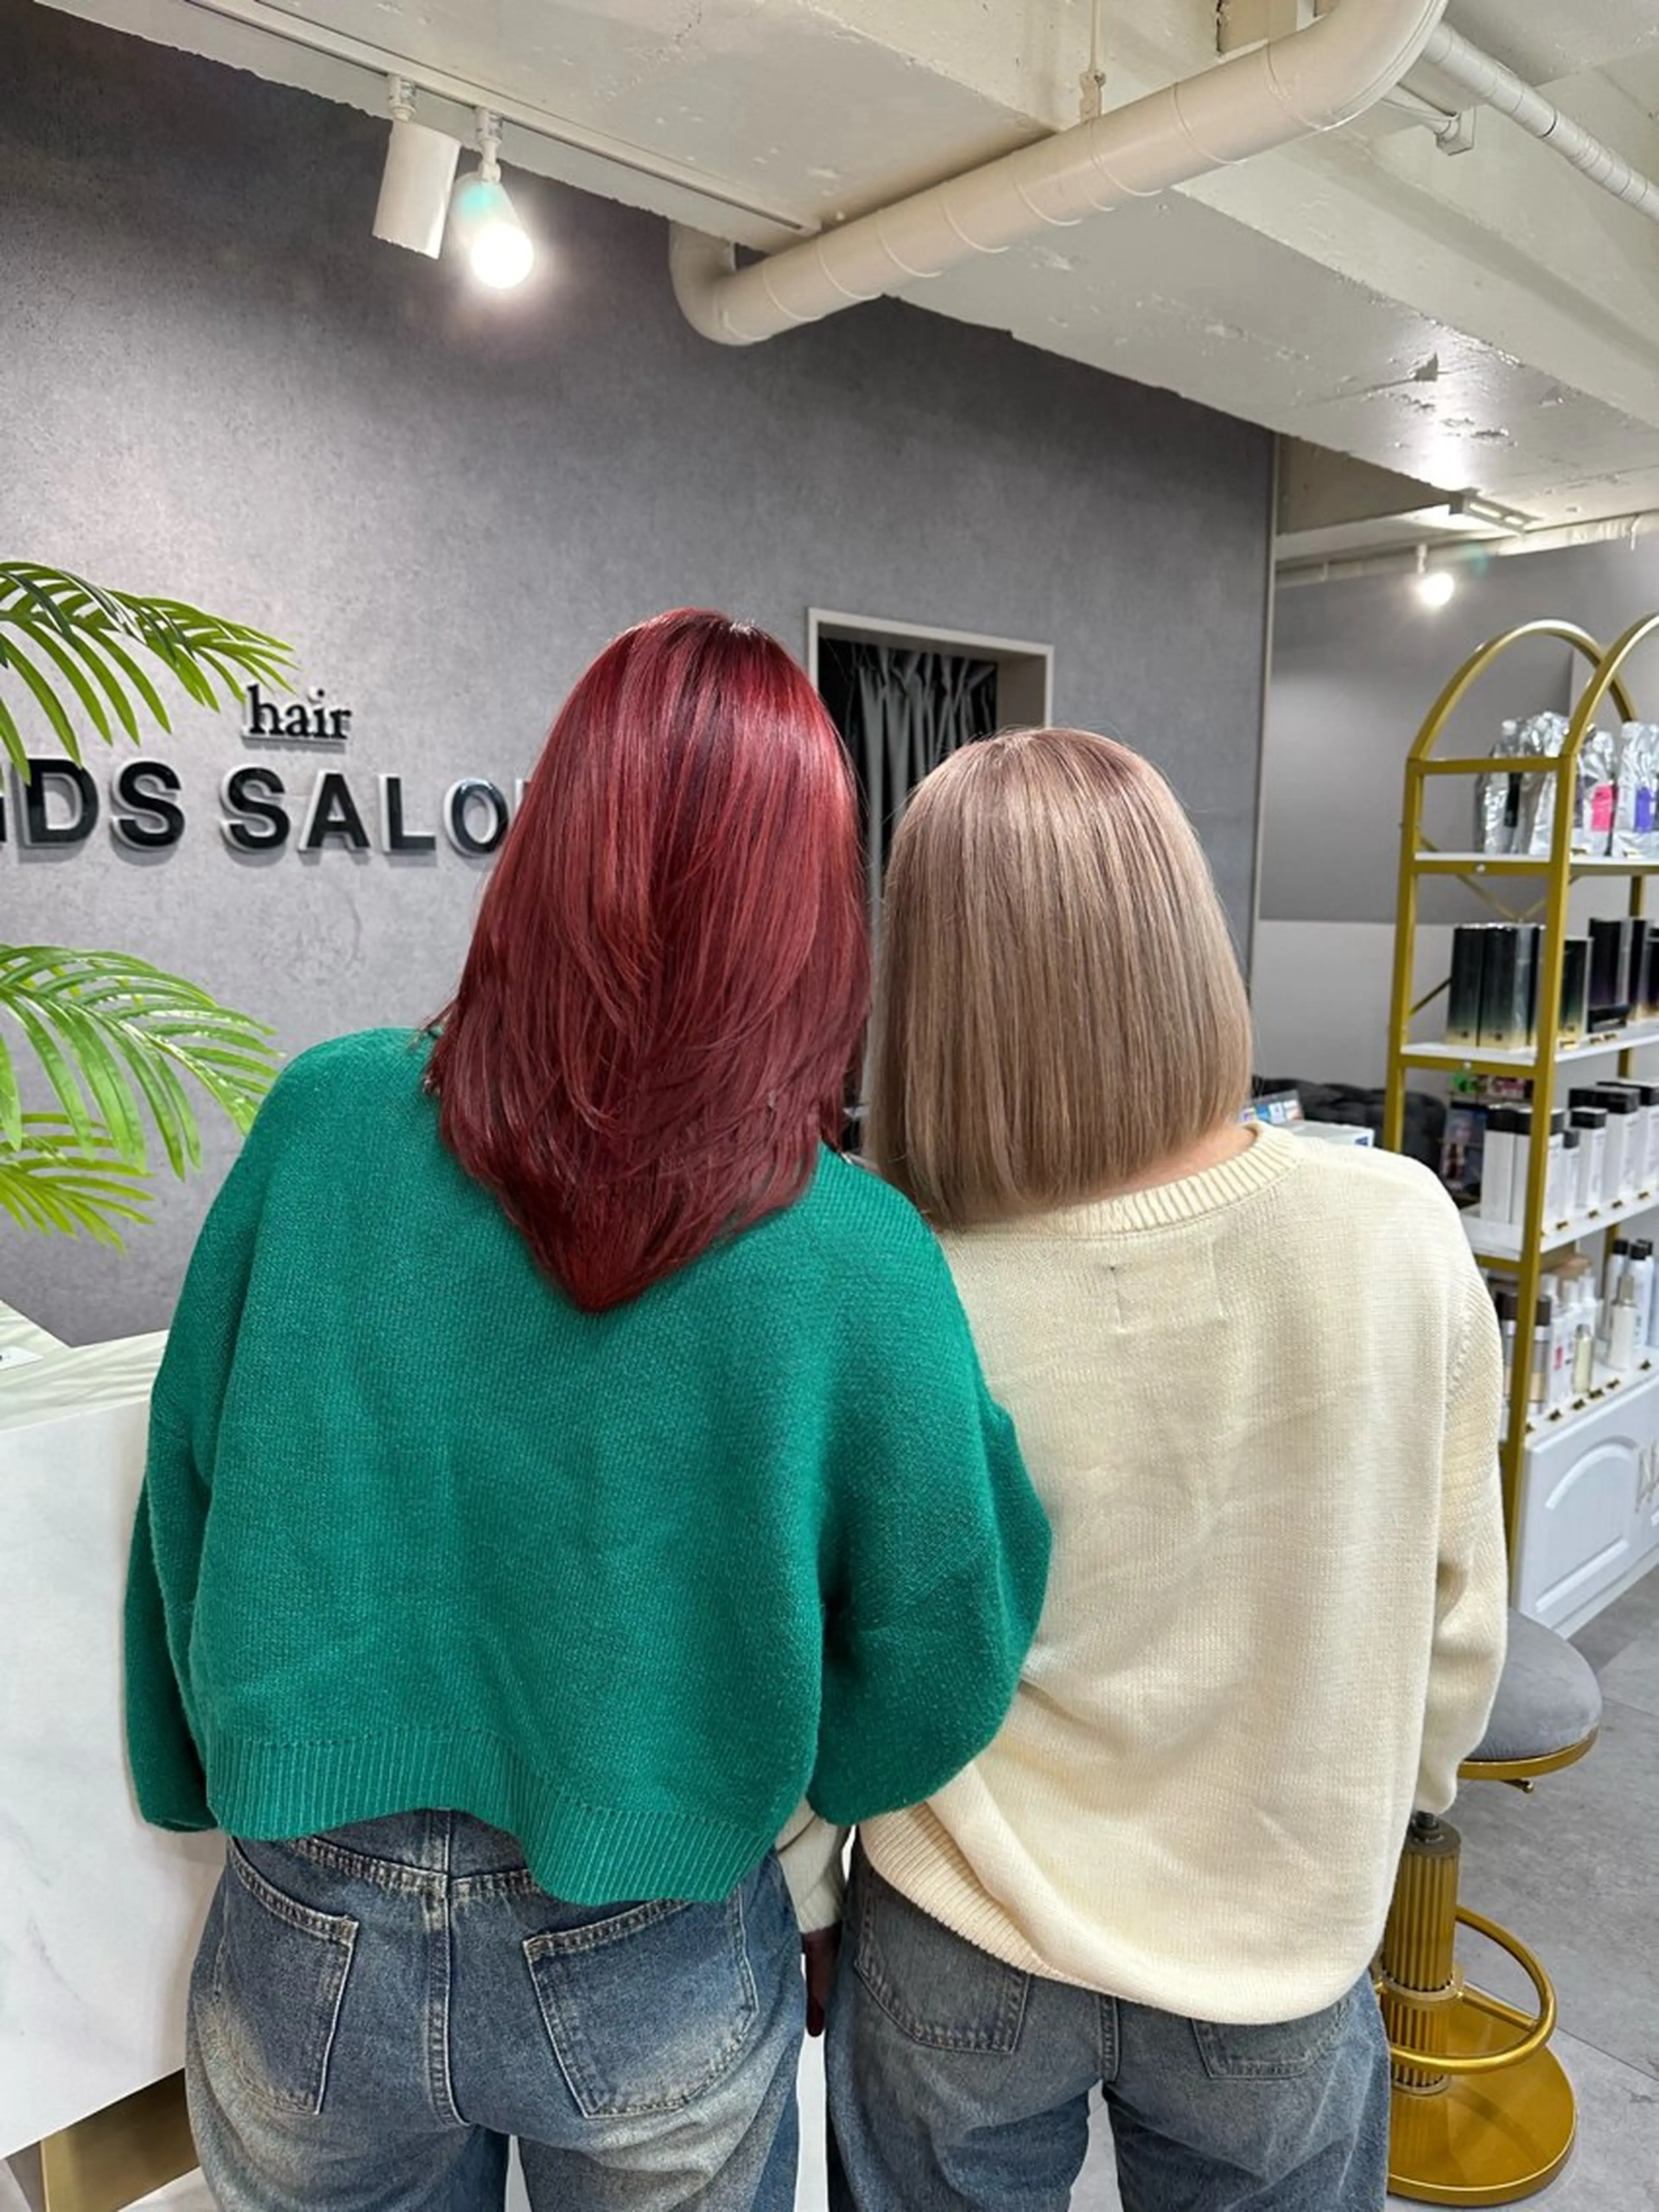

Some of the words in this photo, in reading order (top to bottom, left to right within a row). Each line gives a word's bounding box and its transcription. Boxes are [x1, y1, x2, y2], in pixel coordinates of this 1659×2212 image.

[246, 683, 352, 740] hair
[0, 759, 186, 849] DS
[222, 766, 531, 854] SALO
